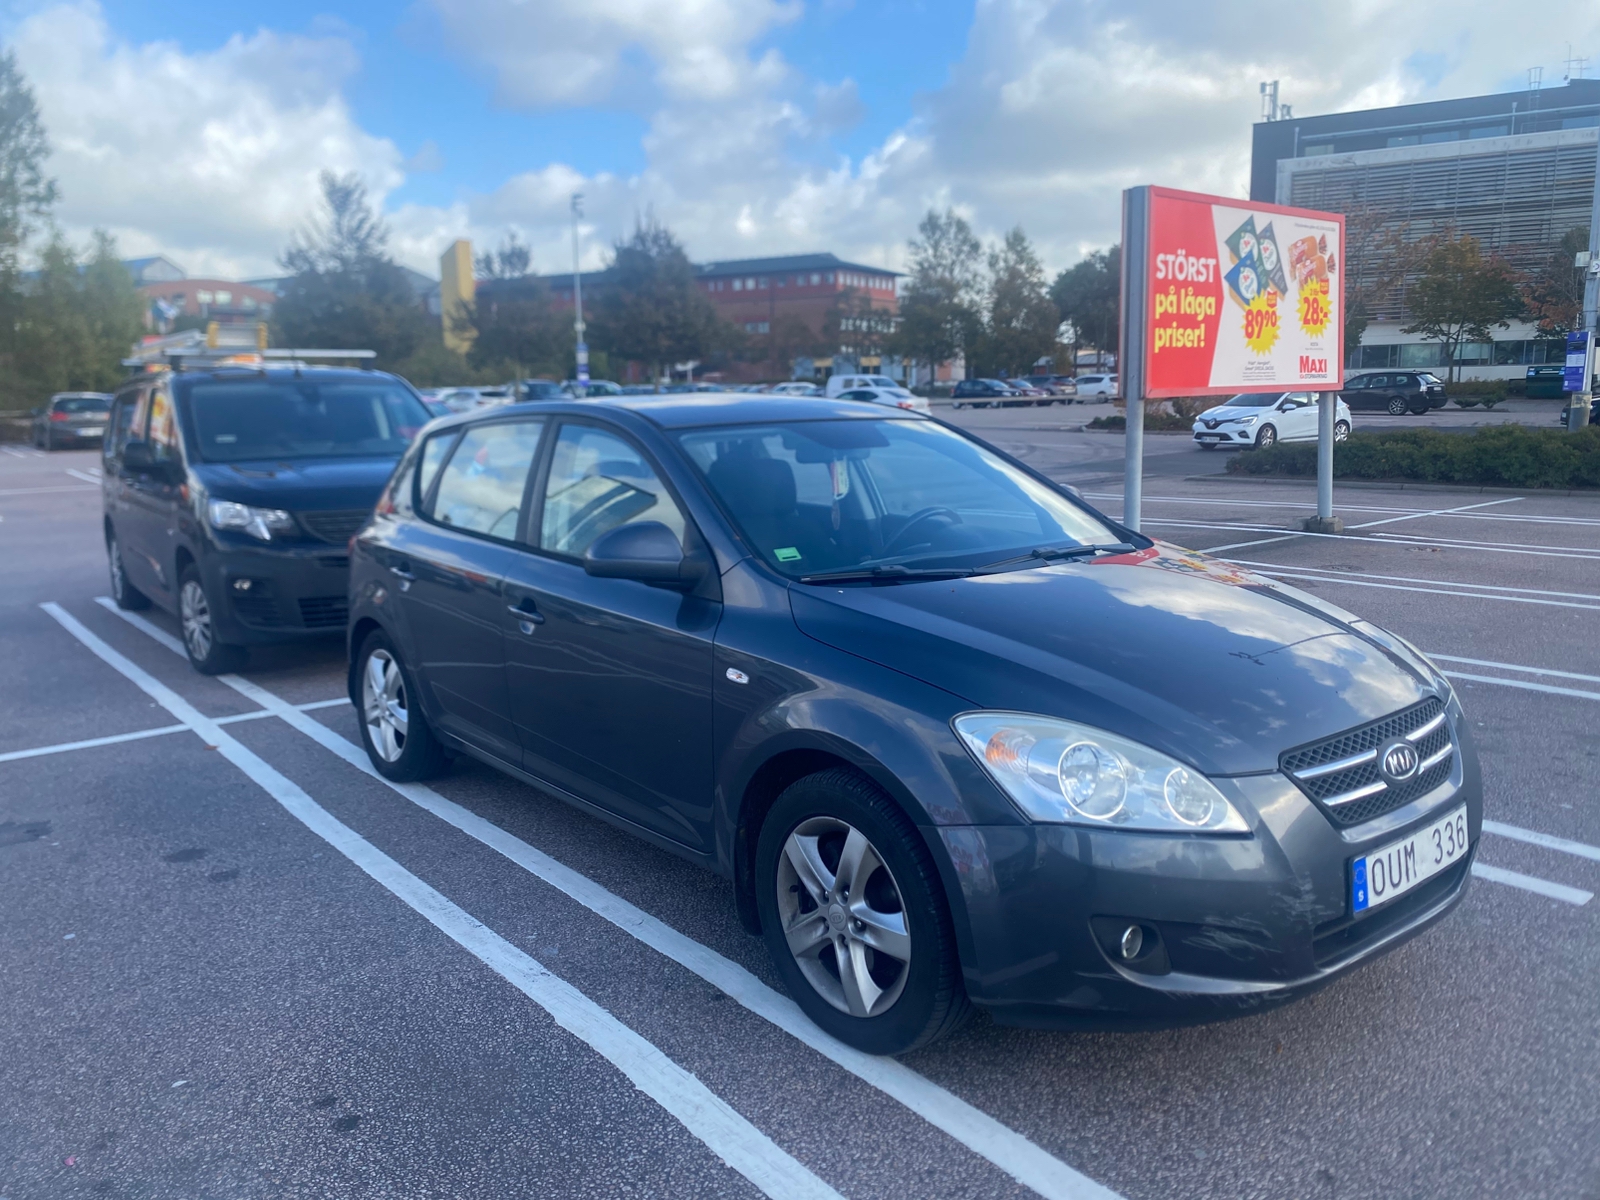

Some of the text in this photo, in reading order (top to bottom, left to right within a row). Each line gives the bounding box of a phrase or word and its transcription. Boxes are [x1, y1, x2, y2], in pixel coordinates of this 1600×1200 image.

[1156, 248, 1217, 283] STÖRST
[1155, 285, 1216, 321] på låga
[1154, 321, 1206, 353] priser!
[1299, 355, 1328, 373] MAXI
[1387, 749, 1415, 775] KIA
[1371, 814, 1465, 897] OUM 336
